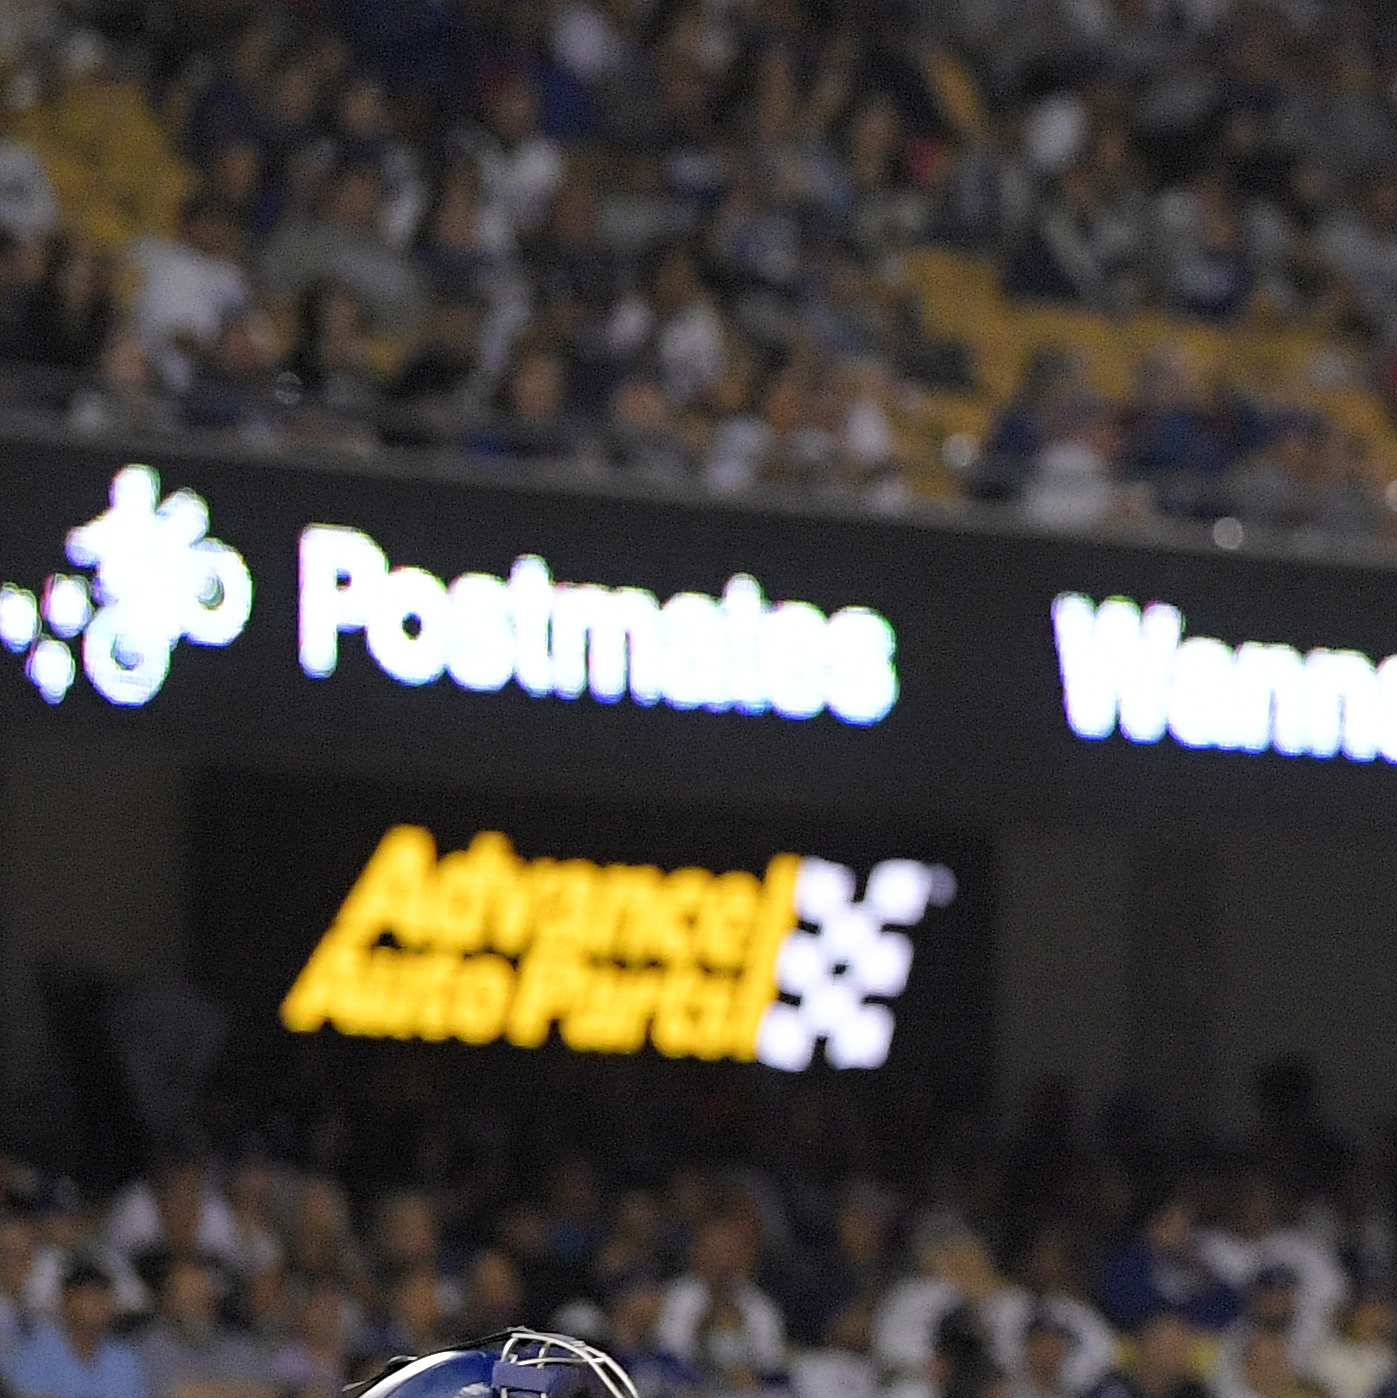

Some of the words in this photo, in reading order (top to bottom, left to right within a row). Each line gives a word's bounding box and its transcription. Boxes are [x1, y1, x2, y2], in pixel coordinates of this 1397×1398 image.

[299, 522, 900, 727] Postmates
[338, 824, 762, 955] Advance
[281, 940, 515, 1045] Auto
